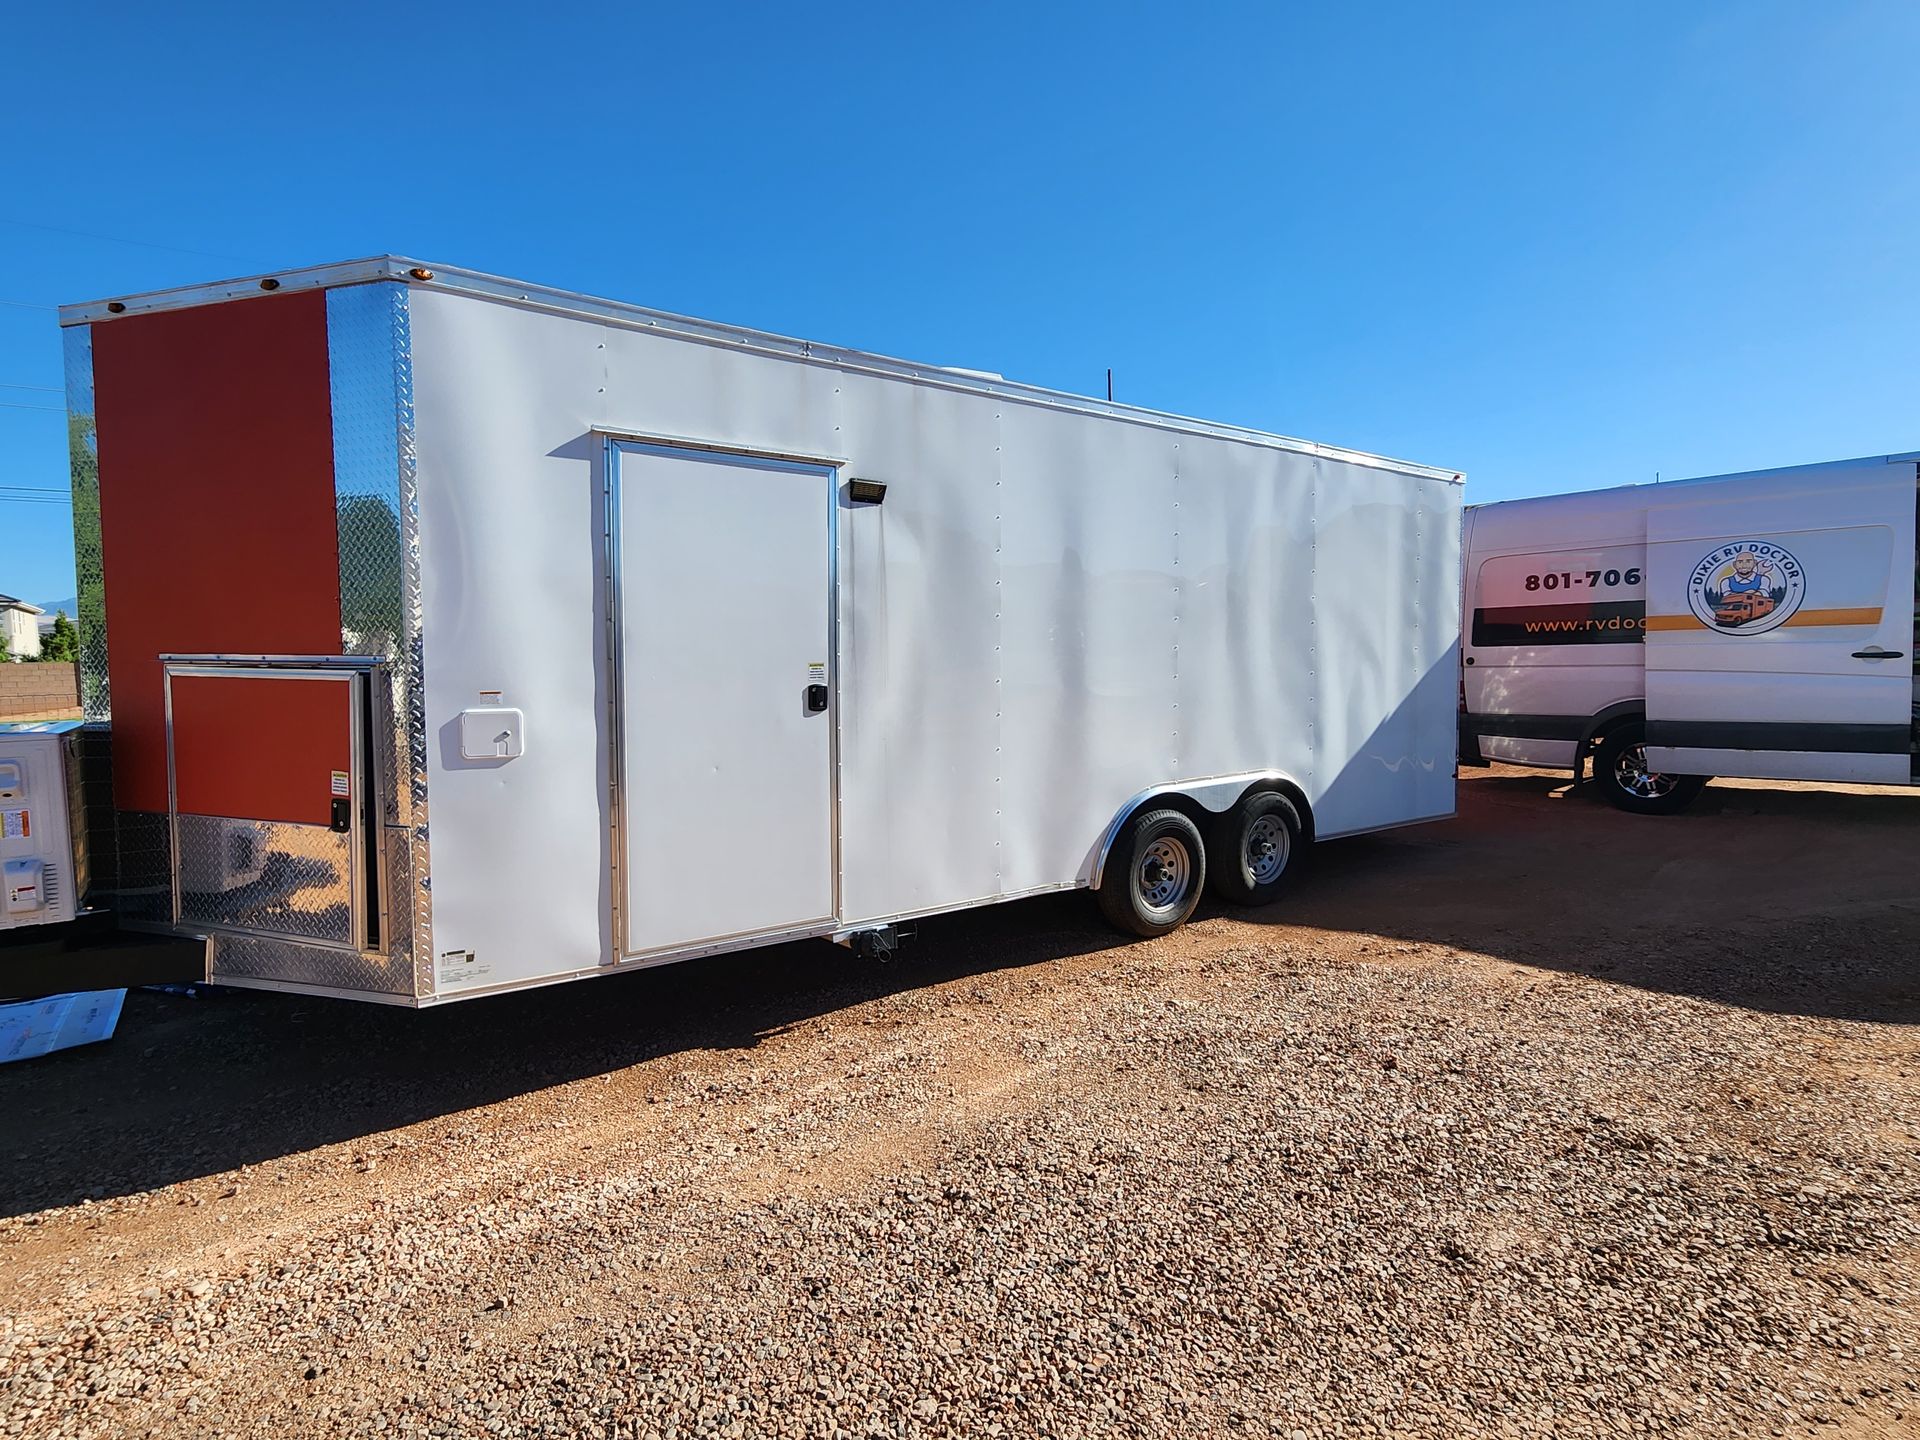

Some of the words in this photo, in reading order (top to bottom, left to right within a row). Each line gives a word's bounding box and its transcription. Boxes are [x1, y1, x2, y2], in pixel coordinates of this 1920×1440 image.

[1693, 554, 1722, 585] DIXIE
[1723, 545, 1743, 558] RV
[1749, 544, 1799, 579] DOCTOR
[1525, 568, 1647, 591] 801-706
[1525, 616, 1647, 633] www.rvdoc
